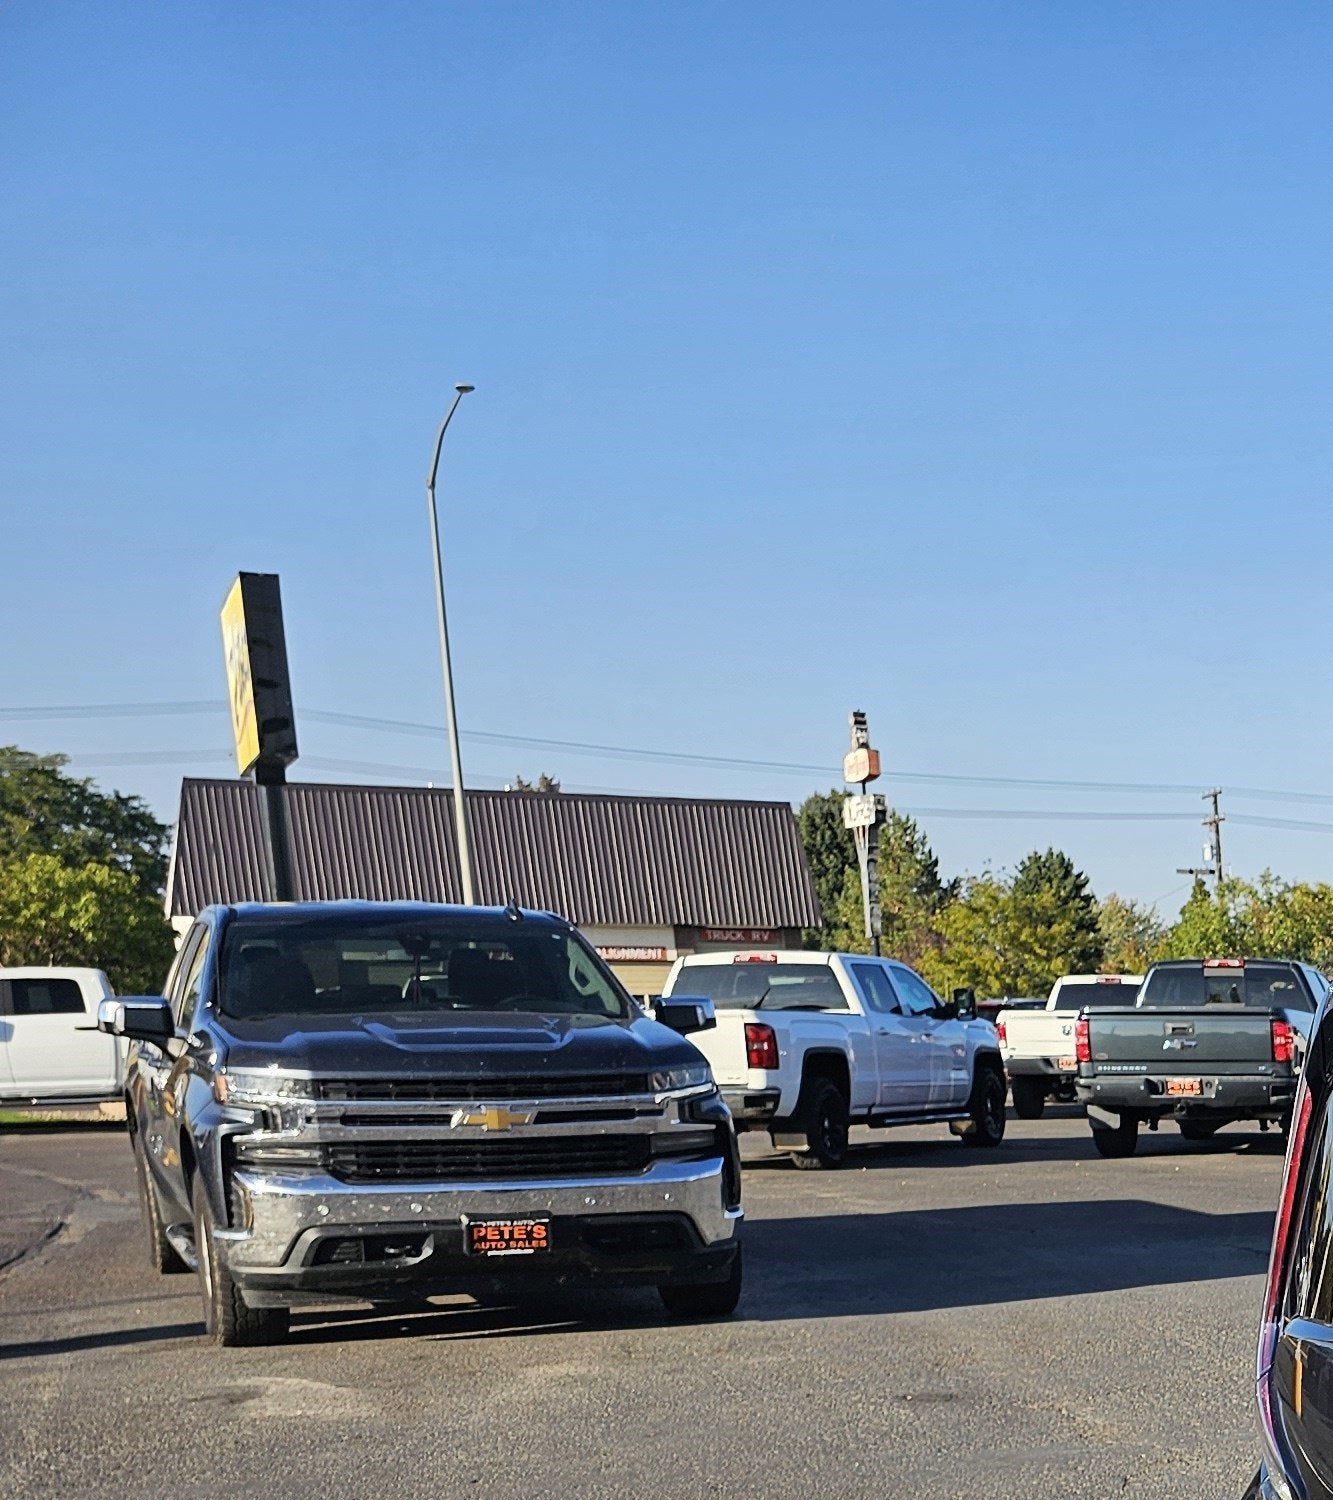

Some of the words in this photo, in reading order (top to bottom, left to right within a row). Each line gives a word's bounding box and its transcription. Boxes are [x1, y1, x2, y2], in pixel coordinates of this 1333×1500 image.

[707, 929, 746, 942] TRUCK
[751, 929, 770, 941] RV
[472, 1224, 547, 1240] PETE'S
[473, 1241, 507, 1250] AUTO
[509, 1239, 547, 1248] SALES
